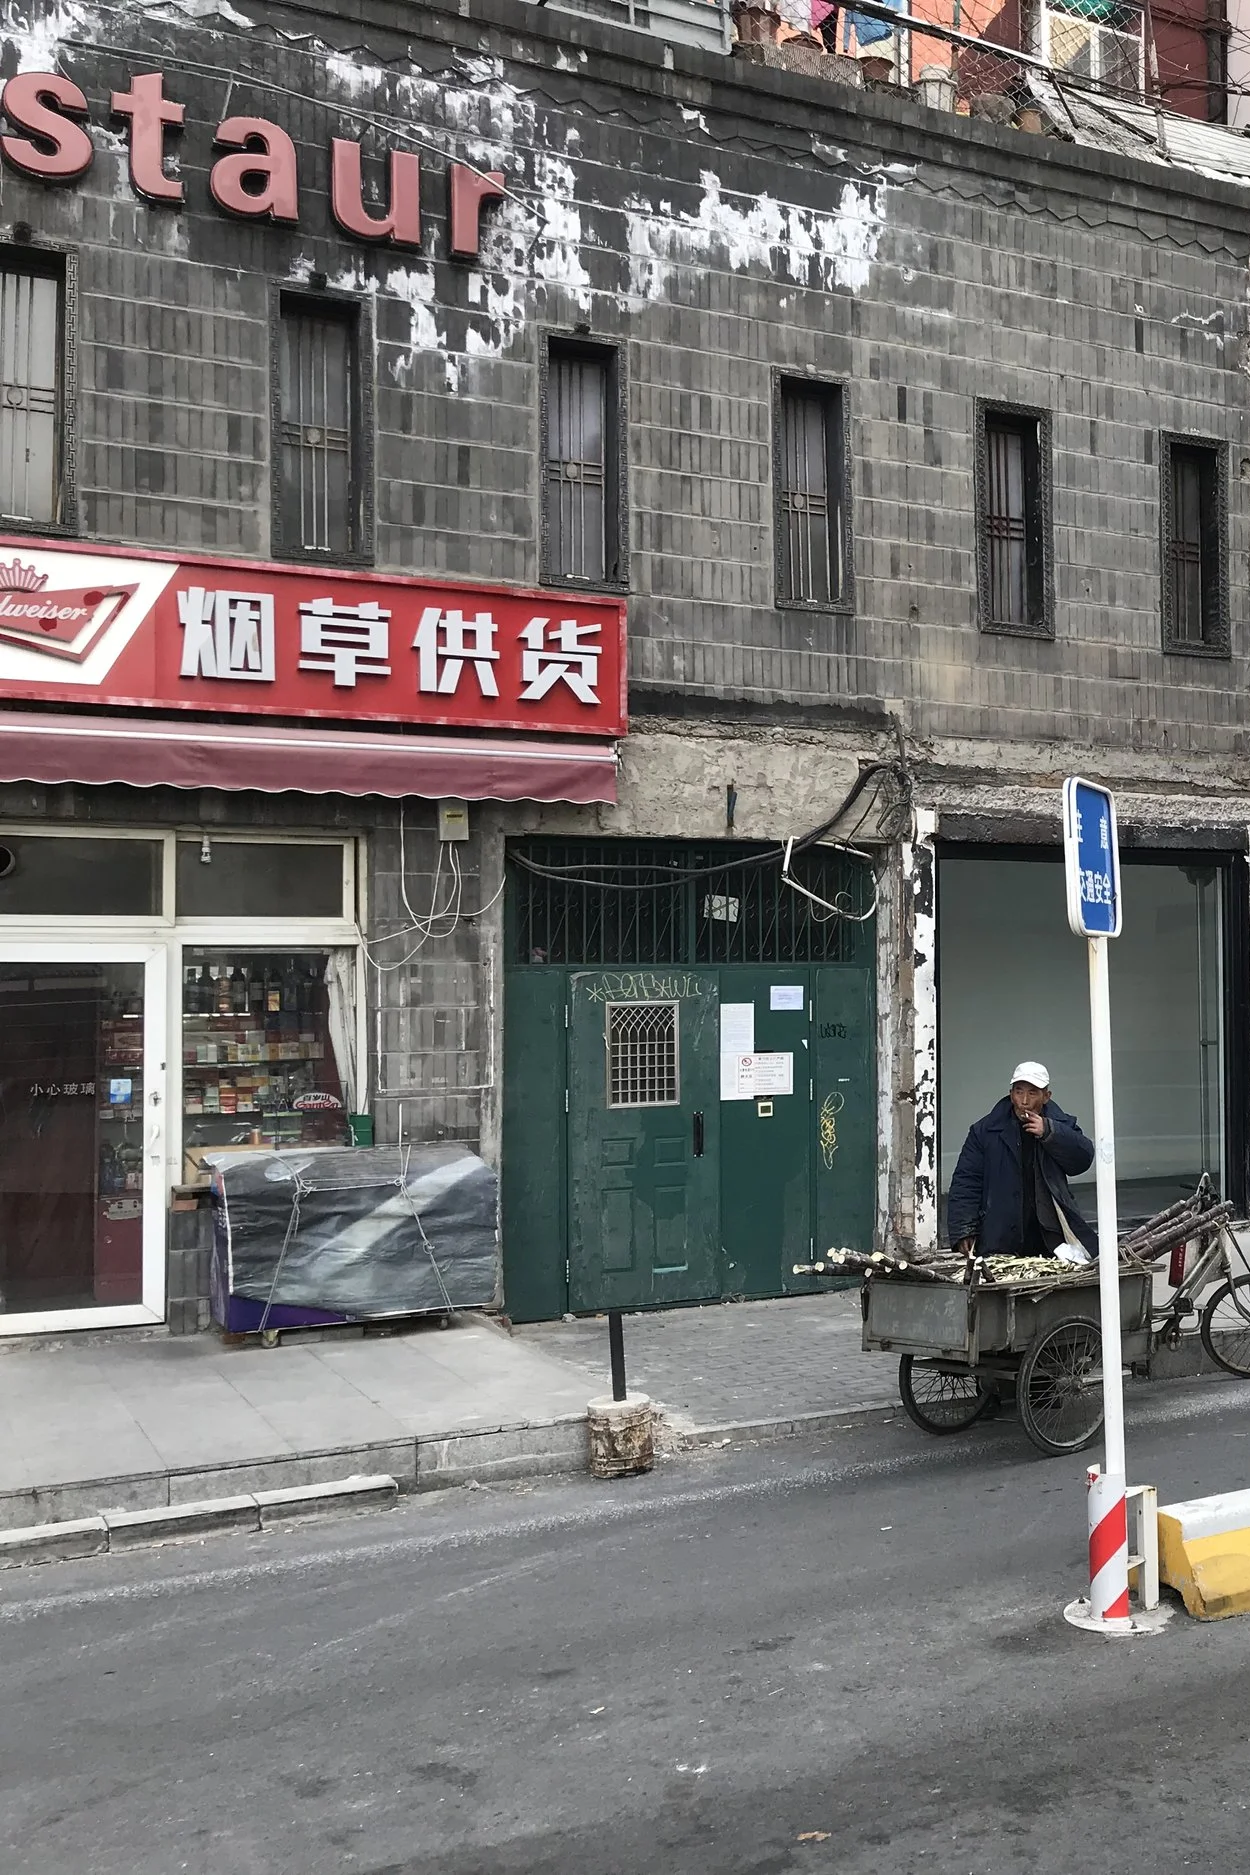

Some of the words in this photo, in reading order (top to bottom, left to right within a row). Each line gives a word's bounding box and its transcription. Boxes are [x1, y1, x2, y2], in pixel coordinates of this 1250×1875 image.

[1, 71, 506, 258] staur
[177, 585, 603, 705] 烟草供货
[30, 1082, 96, 1097] 小心玻璃
